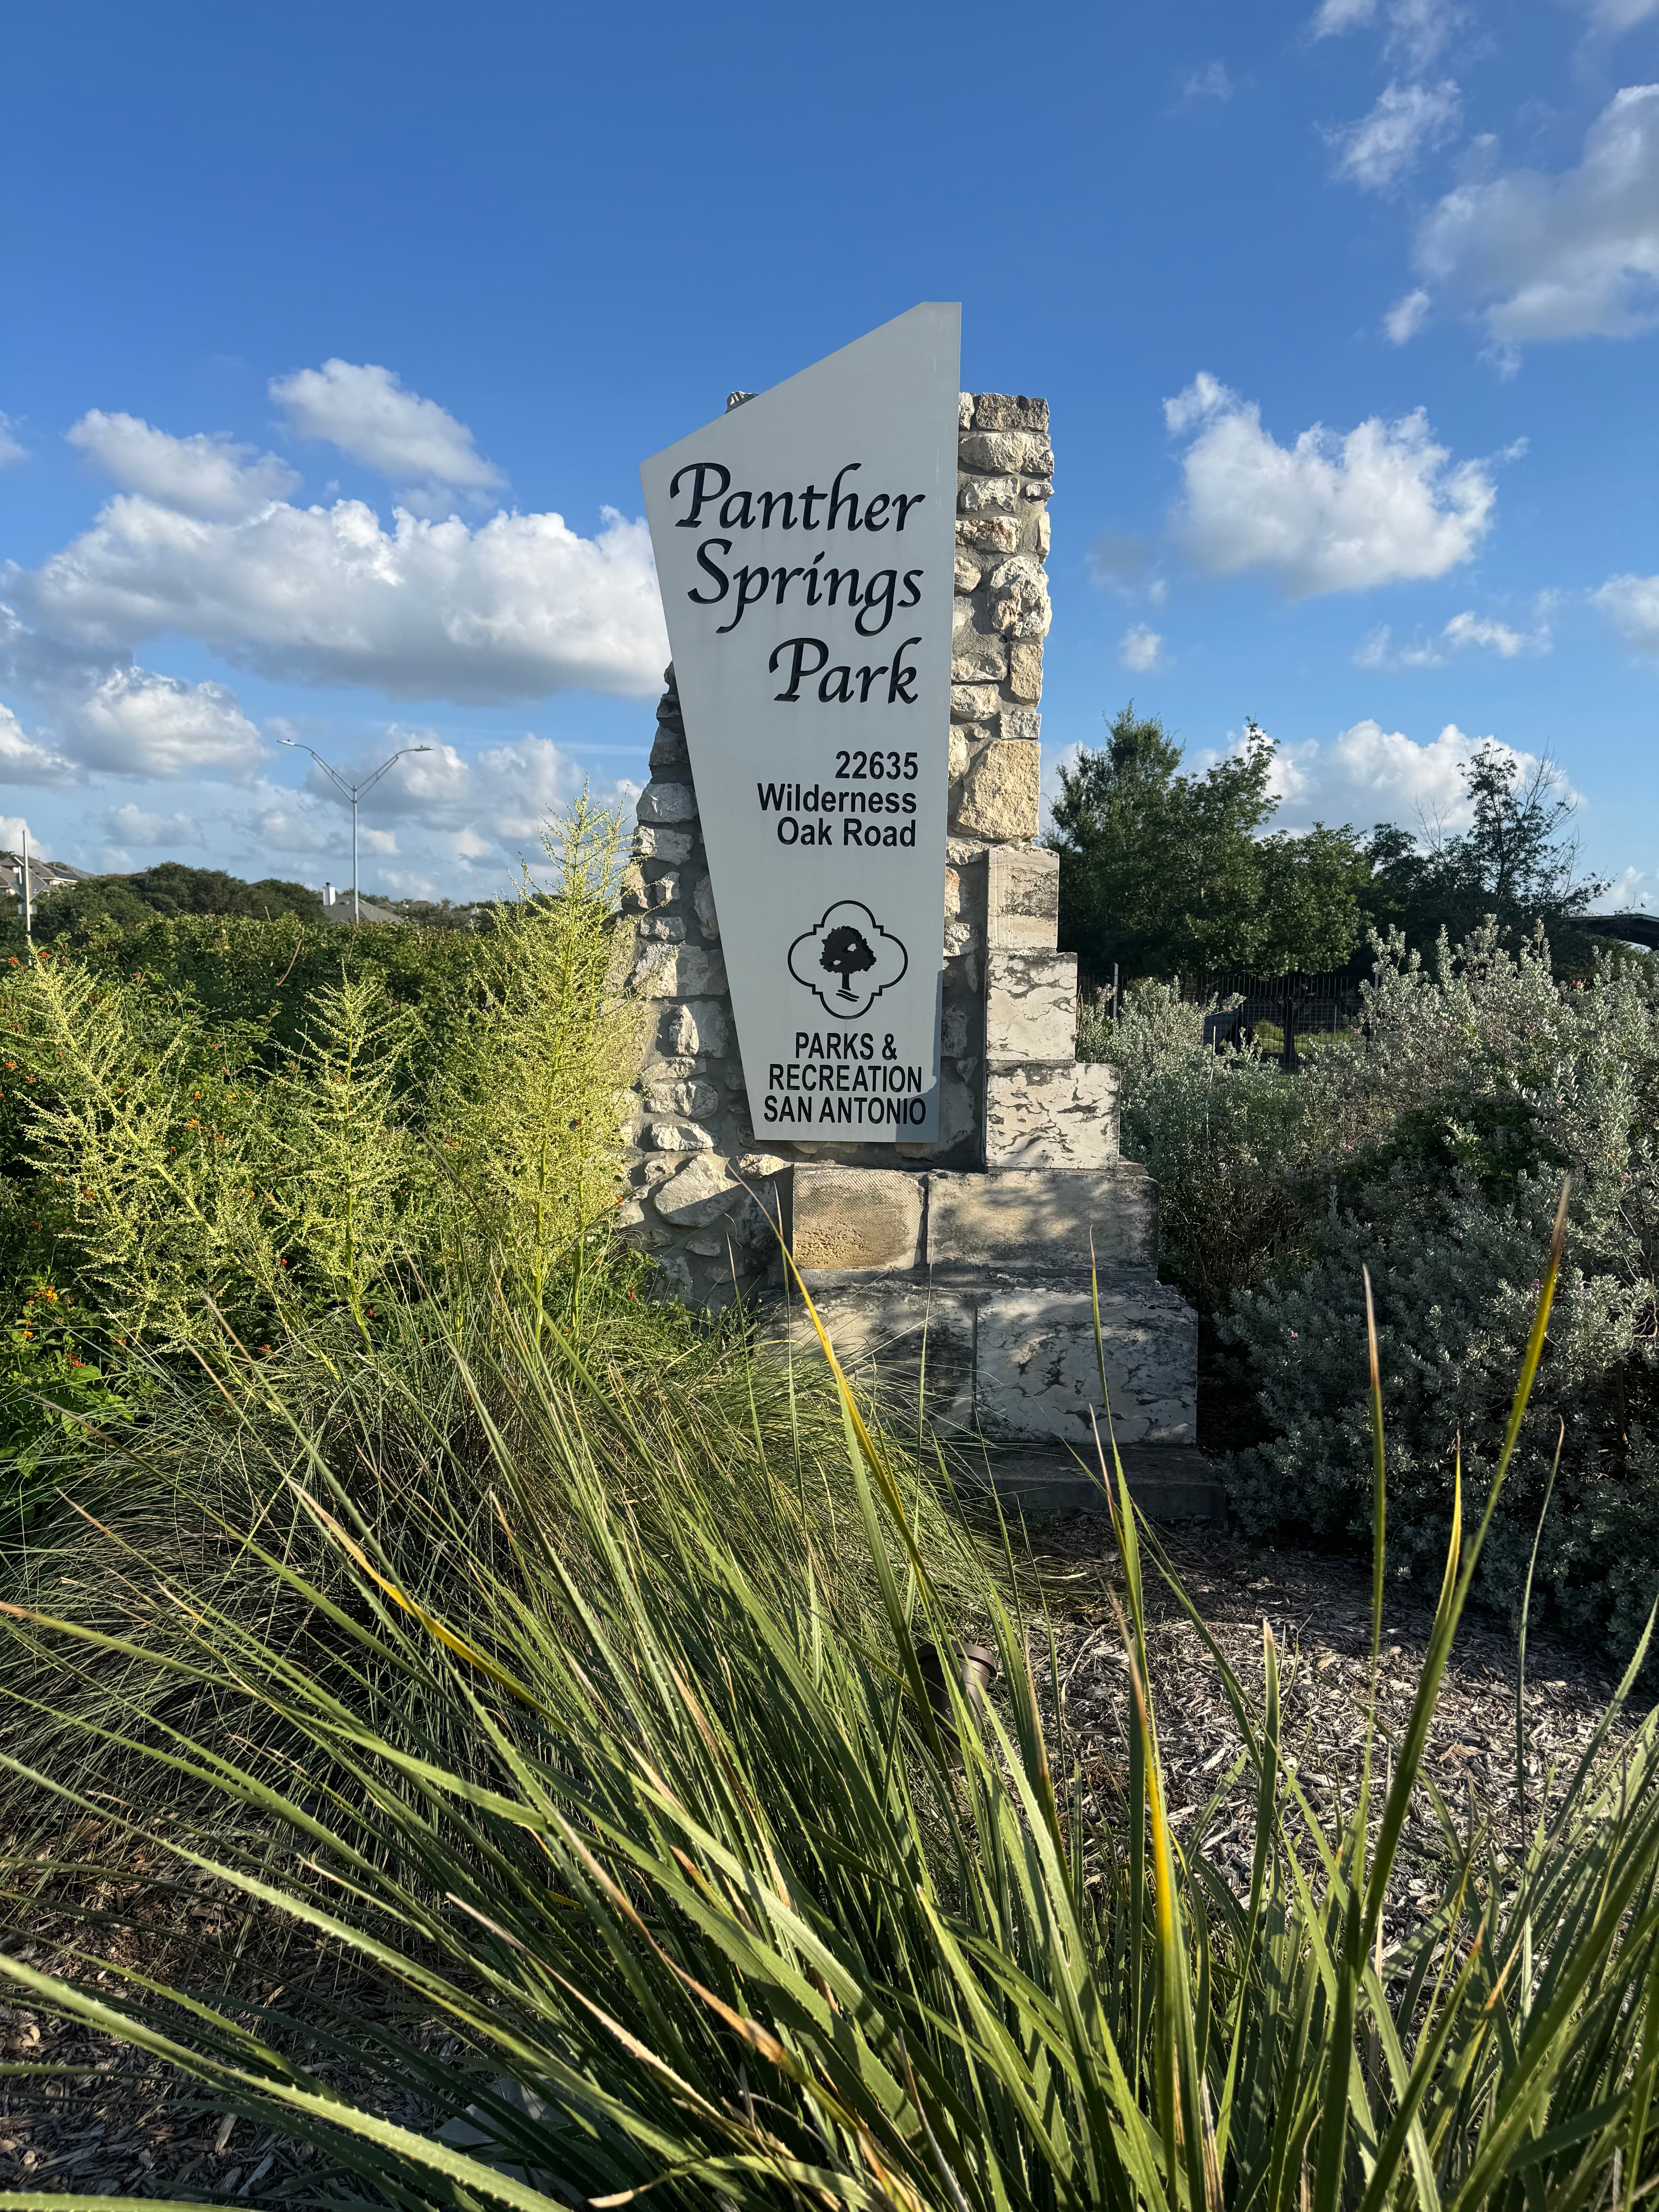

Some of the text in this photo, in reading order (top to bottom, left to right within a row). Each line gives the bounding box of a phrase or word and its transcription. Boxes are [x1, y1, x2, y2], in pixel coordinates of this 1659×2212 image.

[669, 462, 926, 532] Panther
[687, 537, 925, 637] Springs
[768, 636, 922, 705] Park
[835, 750, 919, 781] 22635
[756, 782, 917, 814] Wilderness
[777, 816, 916, 848] Oak Road
[795, 1032, 898, 1061] PARKS &
[769, 1063, 922, 1093] RECREATION
[763, 1095, 927, 1126] SAN ANTONIO
